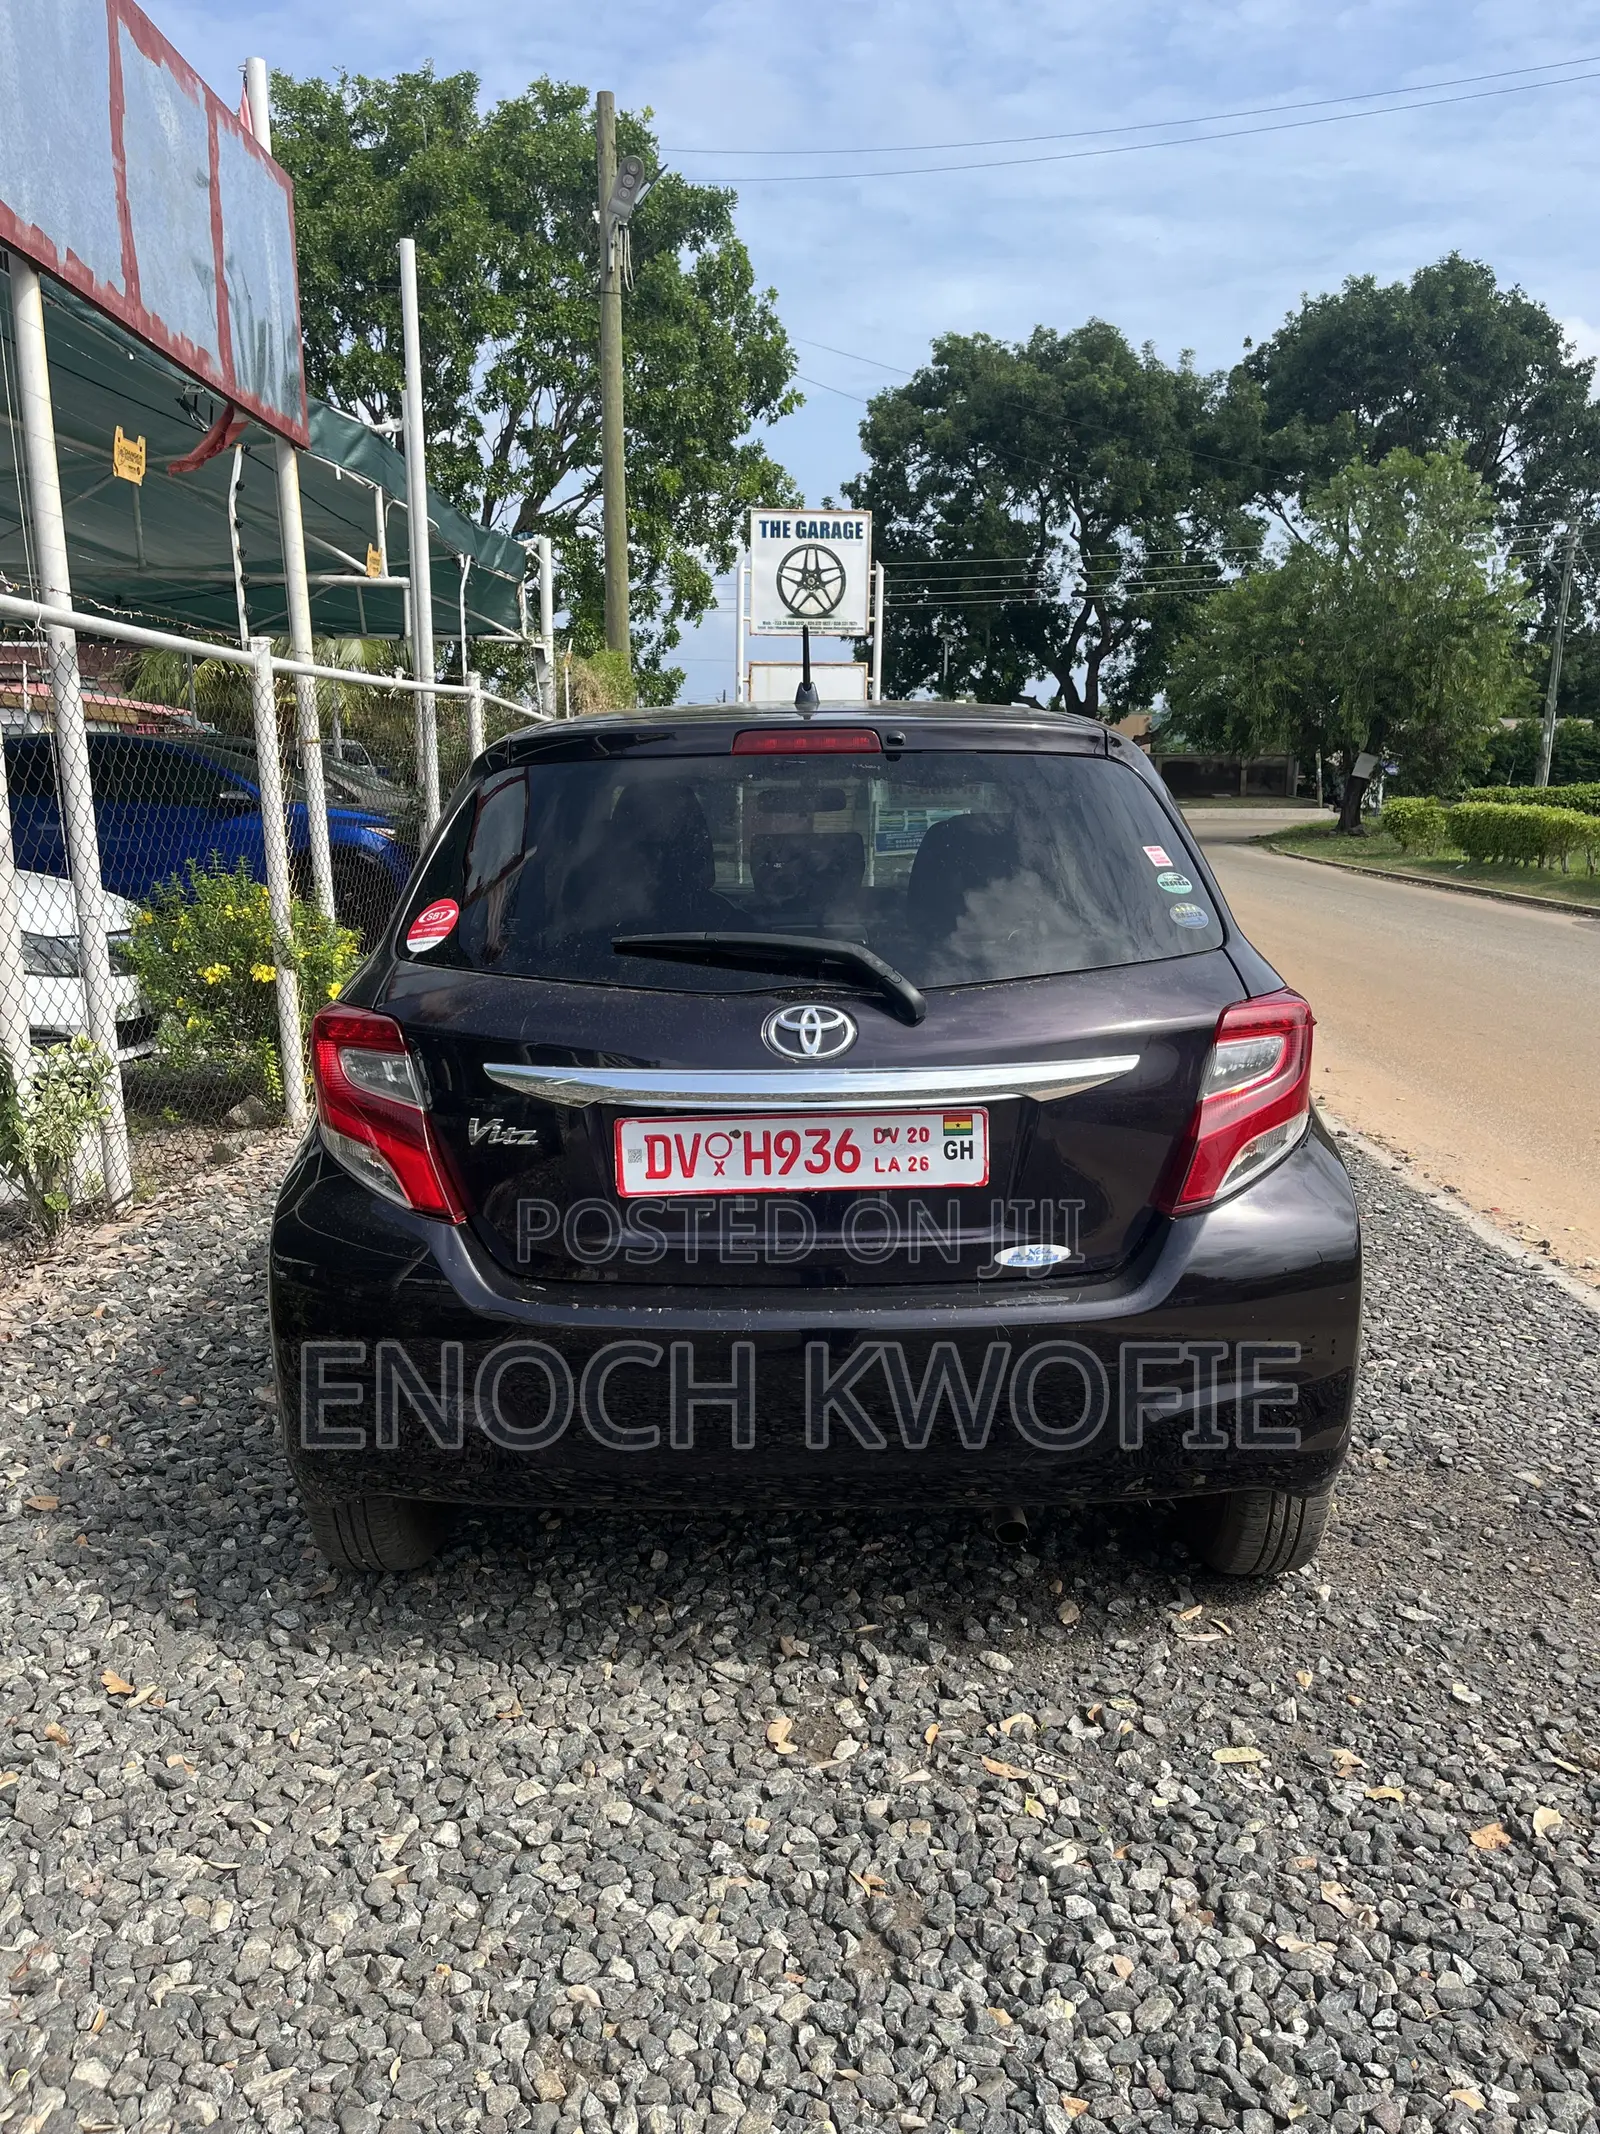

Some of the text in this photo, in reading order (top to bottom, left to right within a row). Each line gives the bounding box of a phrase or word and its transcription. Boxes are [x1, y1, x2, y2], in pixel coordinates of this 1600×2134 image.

[759, 520, 863, 539] THE GARAGE
[427, 911, 447, 921] SBT
[468, 1117, 538, 1145] Vitz
[907, 1127, 930, 1143] 20
[644, 1133, 701, 1179] DV
[743, 1128, 861, 1176] H936
[943, 1140, 974, 1160] GH
[874, 1156, 930, 1173] LA 26
